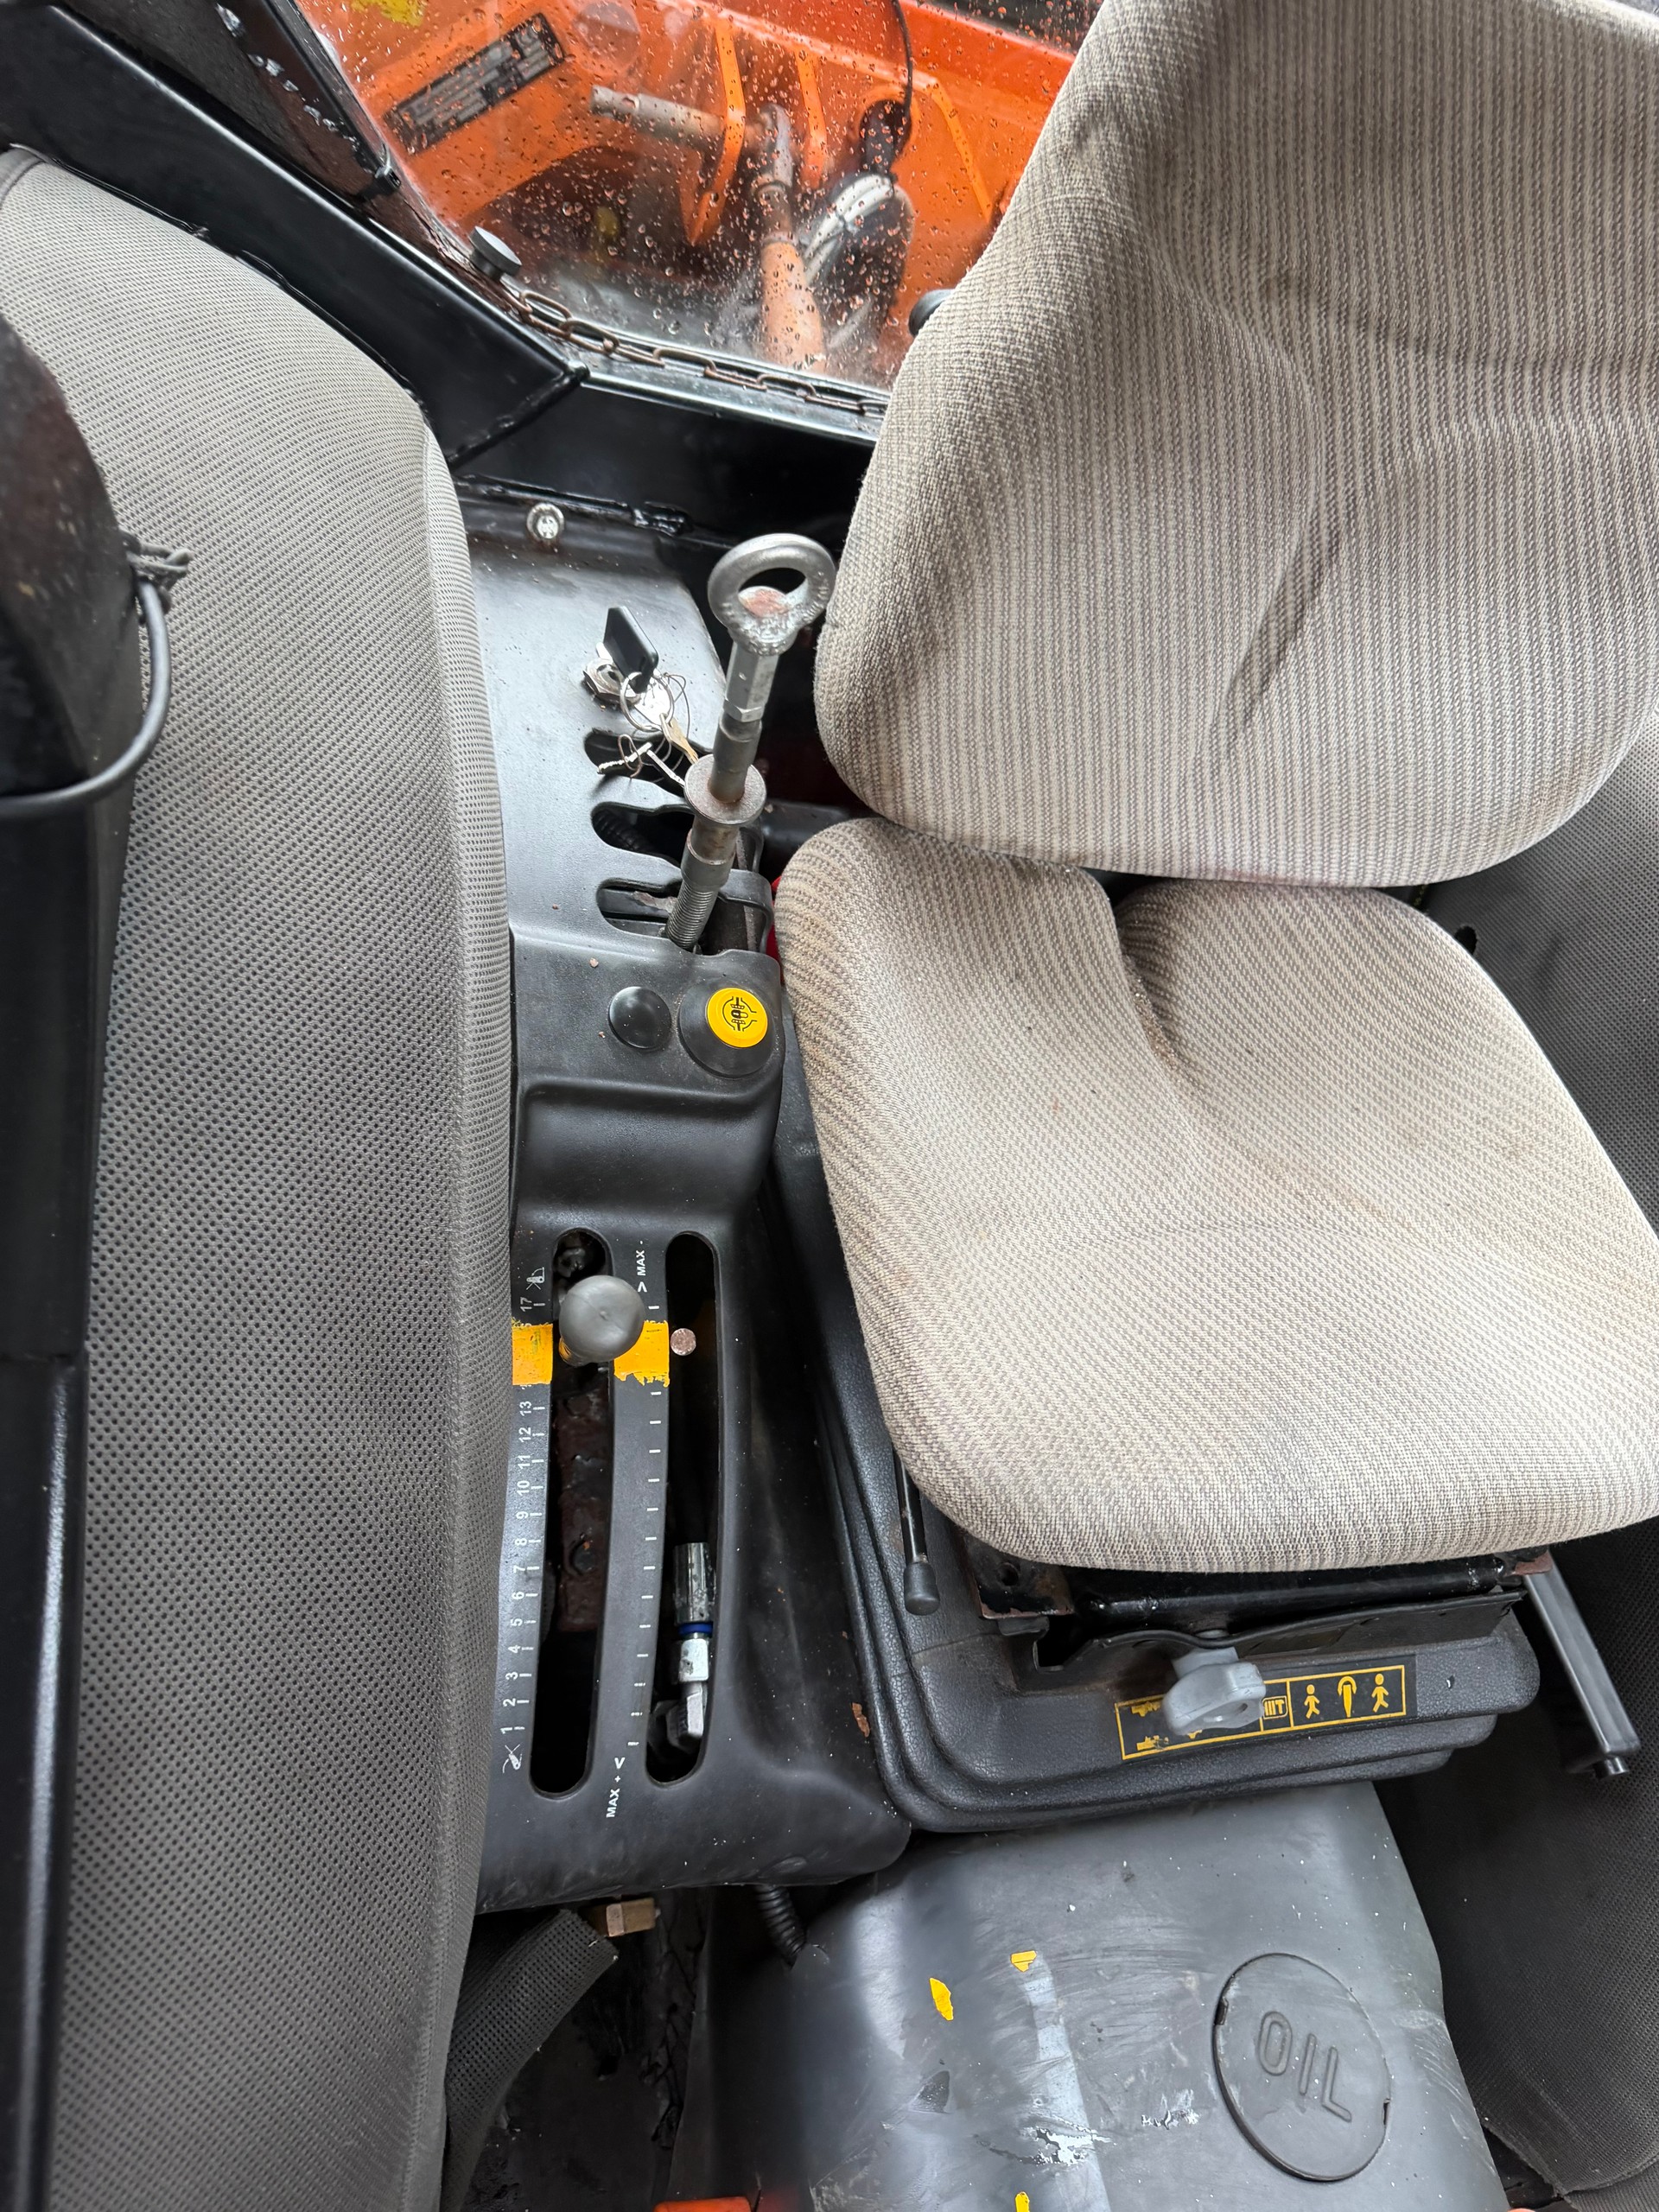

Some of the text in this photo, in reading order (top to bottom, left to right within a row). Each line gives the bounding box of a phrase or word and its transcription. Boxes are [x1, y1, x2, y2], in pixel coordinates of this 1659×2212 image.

[635, 1249, 646, 1276] MAX
[520, 1296, 532, 1312] 17
[519, 1401, 532, 1417] 13
[518, 1426, 531, 1443] 12
[518, 1454, 531, 1470] 11
[517, 1480, 531, 1497] 10
[516, 1510, 529, 1519] 9
[514, 1537, 528, 1546] 8
[512, 1564, 526, 1573] 7
[512, 1590, 524, 1600] 6
[511, 1618, 524, 1627] 5
[508, 1644, 520, 1655] 4
[505, 1670, 519, 1681] 3
[503, 1697, 517, 1707] 2
[606, 1788, 620, 1818] MAX
[1258, 2011, 1352, 2123] OIL
